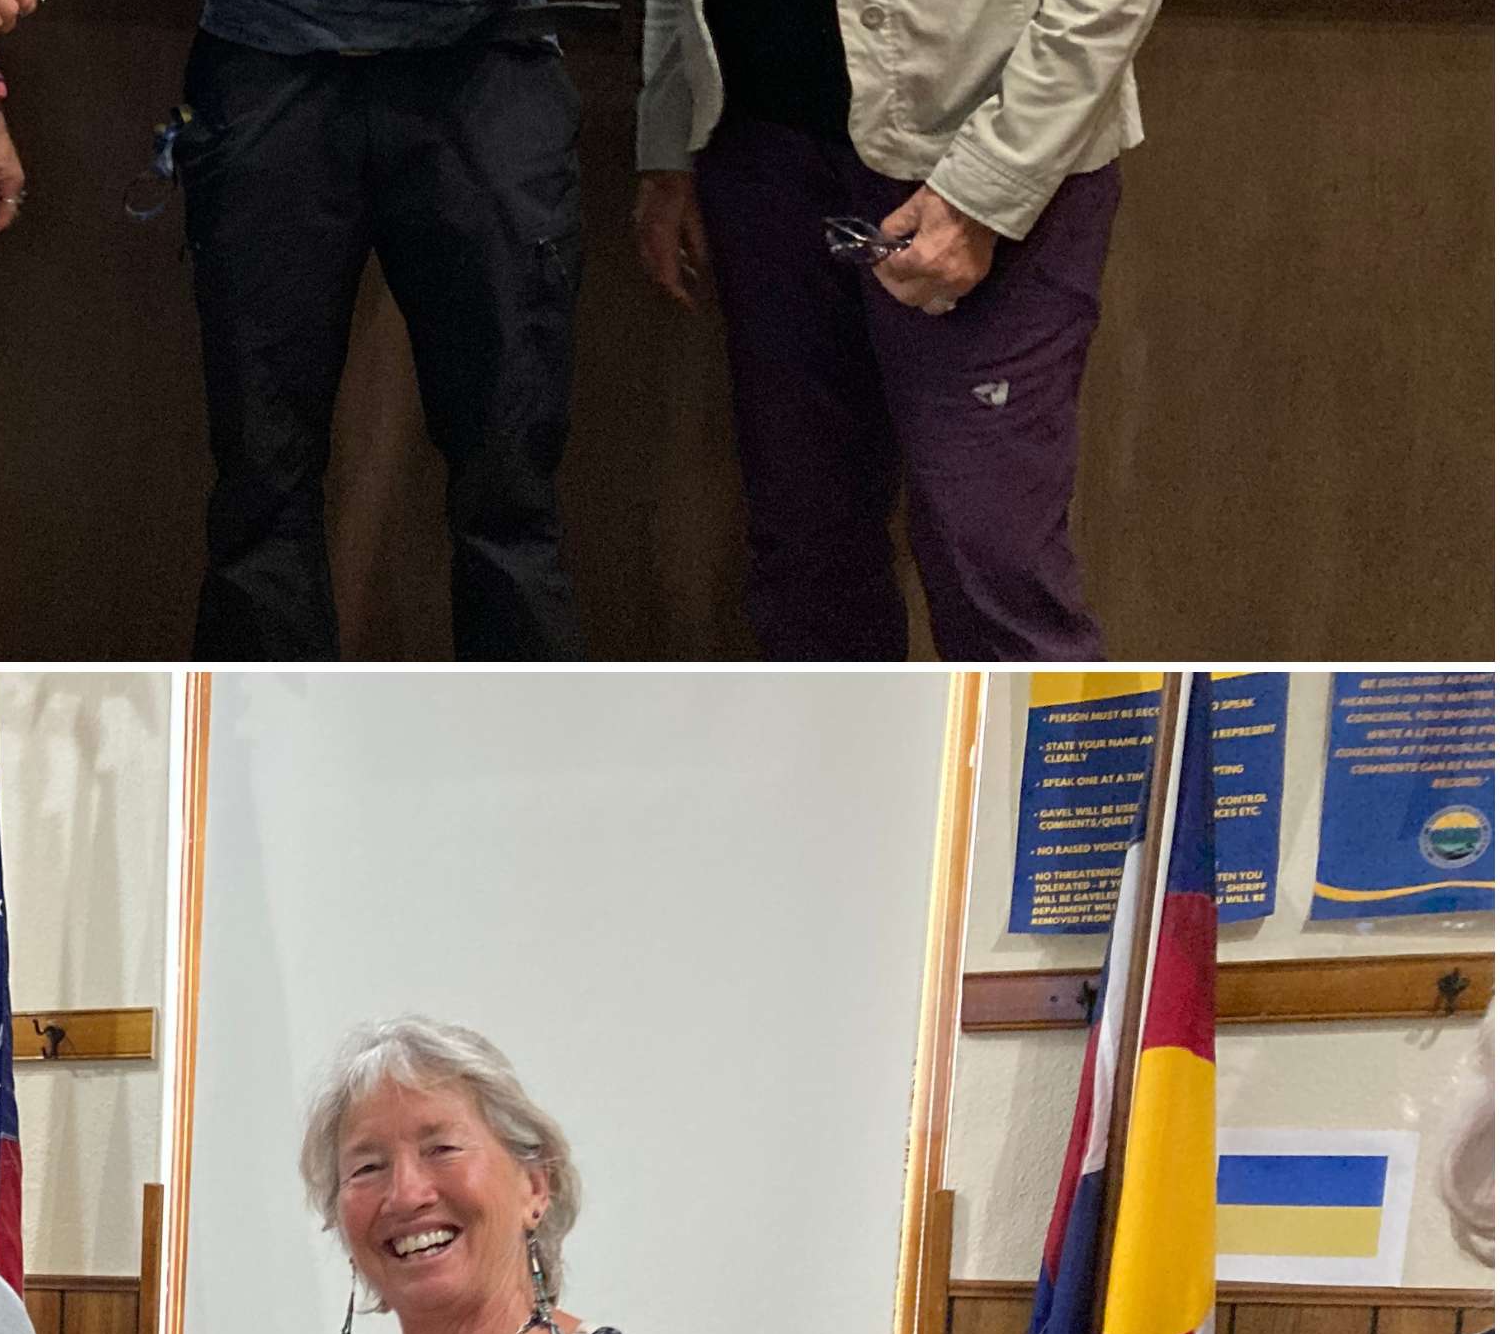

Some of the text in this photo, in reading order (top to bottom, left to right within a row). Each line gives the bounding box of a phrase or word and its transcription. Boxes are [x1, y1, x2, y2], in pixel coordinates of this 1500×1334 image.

[1049, 710, 1090, 723] PERSON
[1045, 723, 1277, 752] STATE YOUR NAME REPRESENT
[1044, 752, 1088, 764] CLEARLY
[1042, 776, 1075, 788] SPEAK
[1076, 775, 1098, 787] ONE
[1100, 774, 1117, 785] AT
[1126, 771, 1145, 782] TIM
[1039, 807, 1073, 819] GAVEL
[1075, 806, 1100, 817] WILL
[1101, 805, 1114, 815] BE
[1216, 794, 1268, 806] CONTROL
[1036, 845, 1054, 856] NO
[1055, 843, 1092, 855] RAISED
[1033, 880, 1090, 893] TOLERATED
[1238, 870, 1264, 881] YOU
[1035, 871, 1052, 882] NO
[1033, 894, 1057, 906] WILL
[1059, 893, 1072, 904] BE
[1225, 881, 1268, 893] SHERIFF
[1031, 892, 1266, 917] DEPARMENT WILL BE
[1030, 915, 1080, 926] REMOVED
